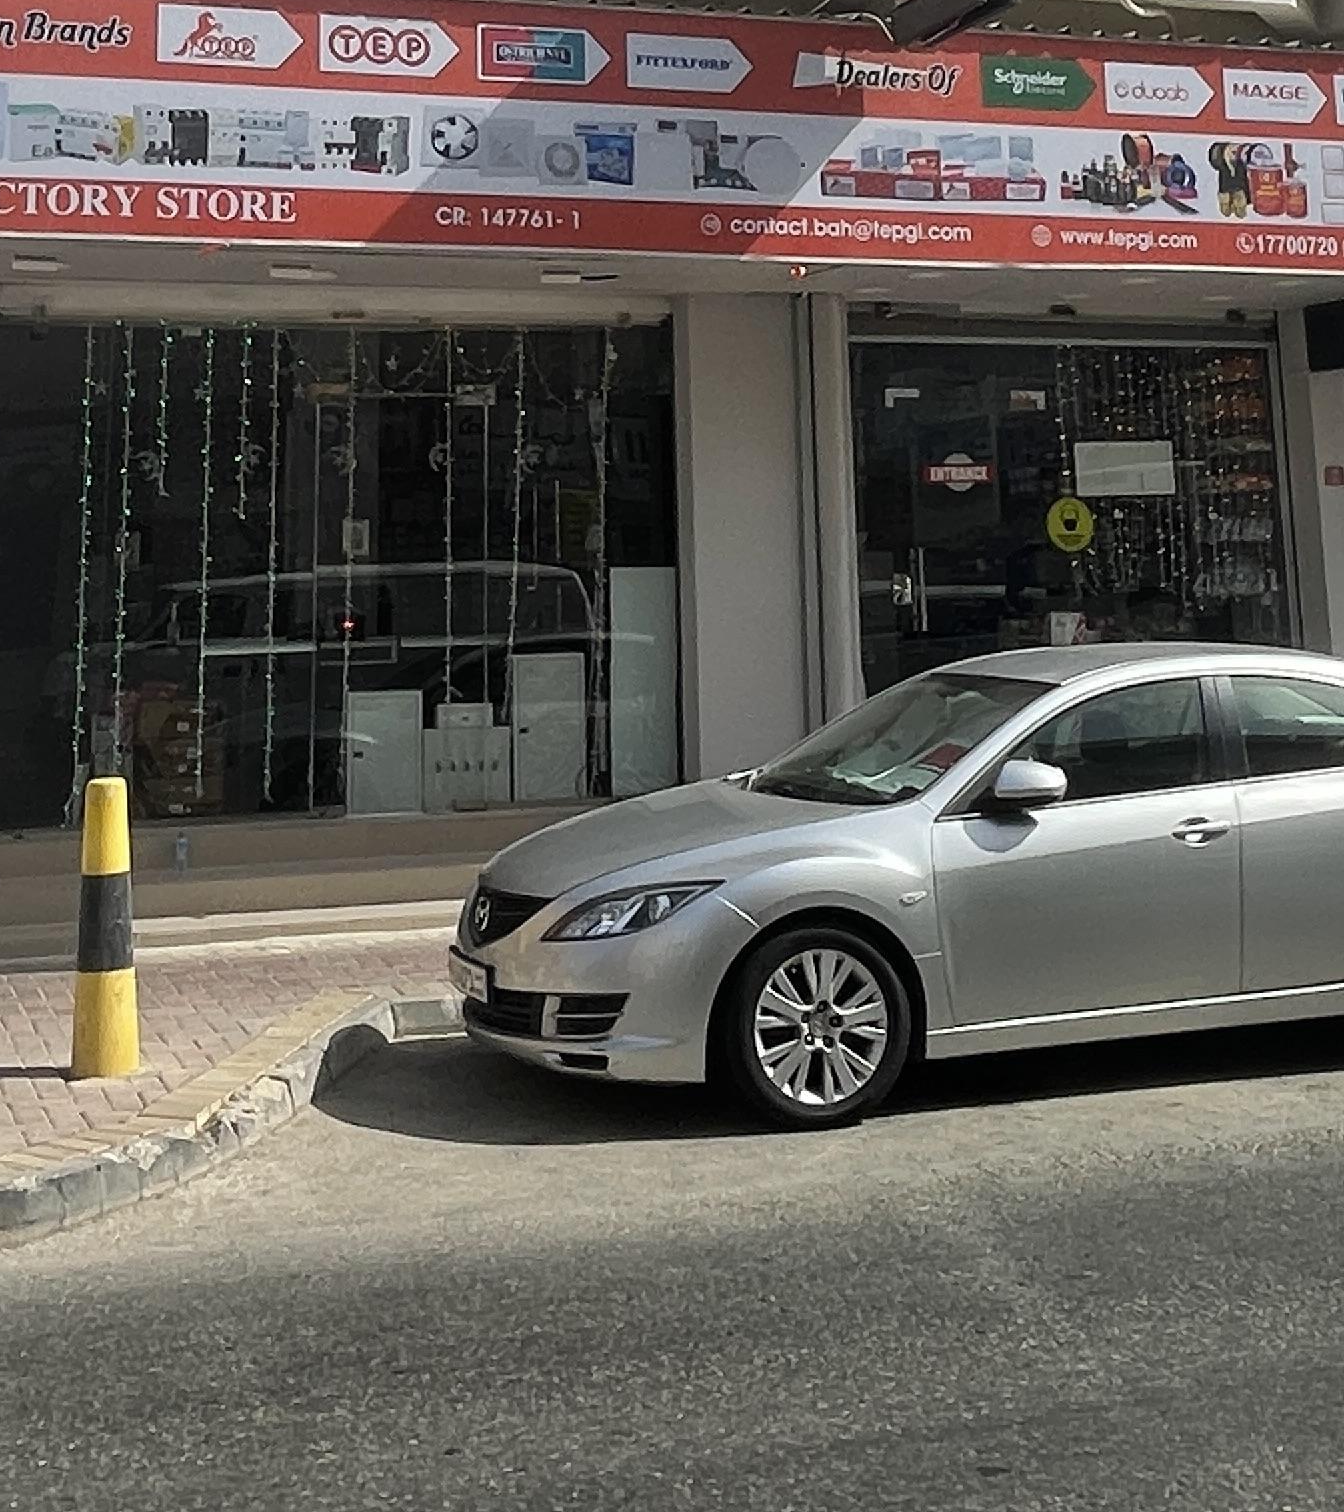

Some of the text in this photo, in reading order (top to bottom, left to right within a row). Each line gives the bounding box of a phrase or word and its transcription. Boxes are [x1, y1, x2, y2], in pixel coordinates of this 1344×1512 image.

[24, 11, 131, 50] Brands
[333, 28, 426, 63] TEP
[836, 60, 958, 95] Dealers Of
[994, 69, 1067, 93] Schneider
[156, 186, 297, 223] STORE
[435, 206, 472, 227] CR:
[1257, 234, 1338, 256] 17700720
